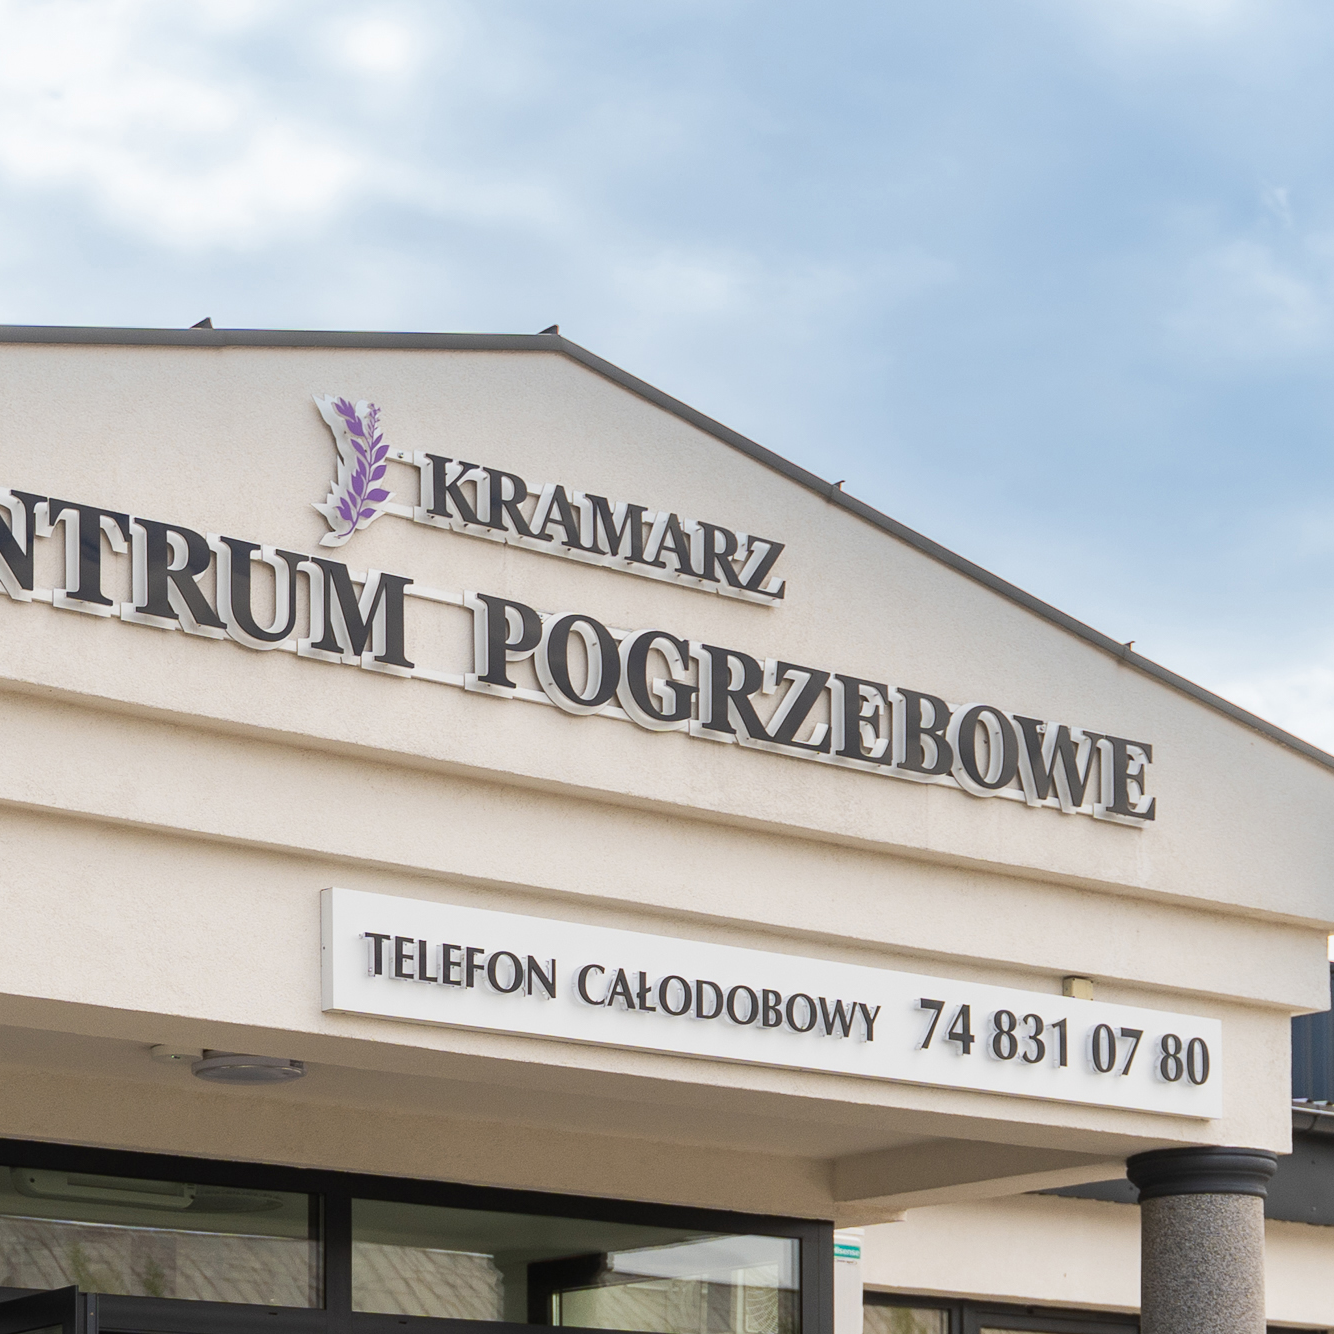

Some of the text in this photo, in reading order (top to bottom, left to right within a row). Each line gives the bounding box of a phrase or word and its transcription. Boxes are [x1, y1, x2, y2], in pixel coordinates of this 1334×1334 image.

[424, 453, 787, 600] KRAMARZ
[476, 592, 1157, 821] POGRZEBOWE
[363, 931, 1210, 1086] TELEFON CAŁODOBOWY 74 831 07 80
